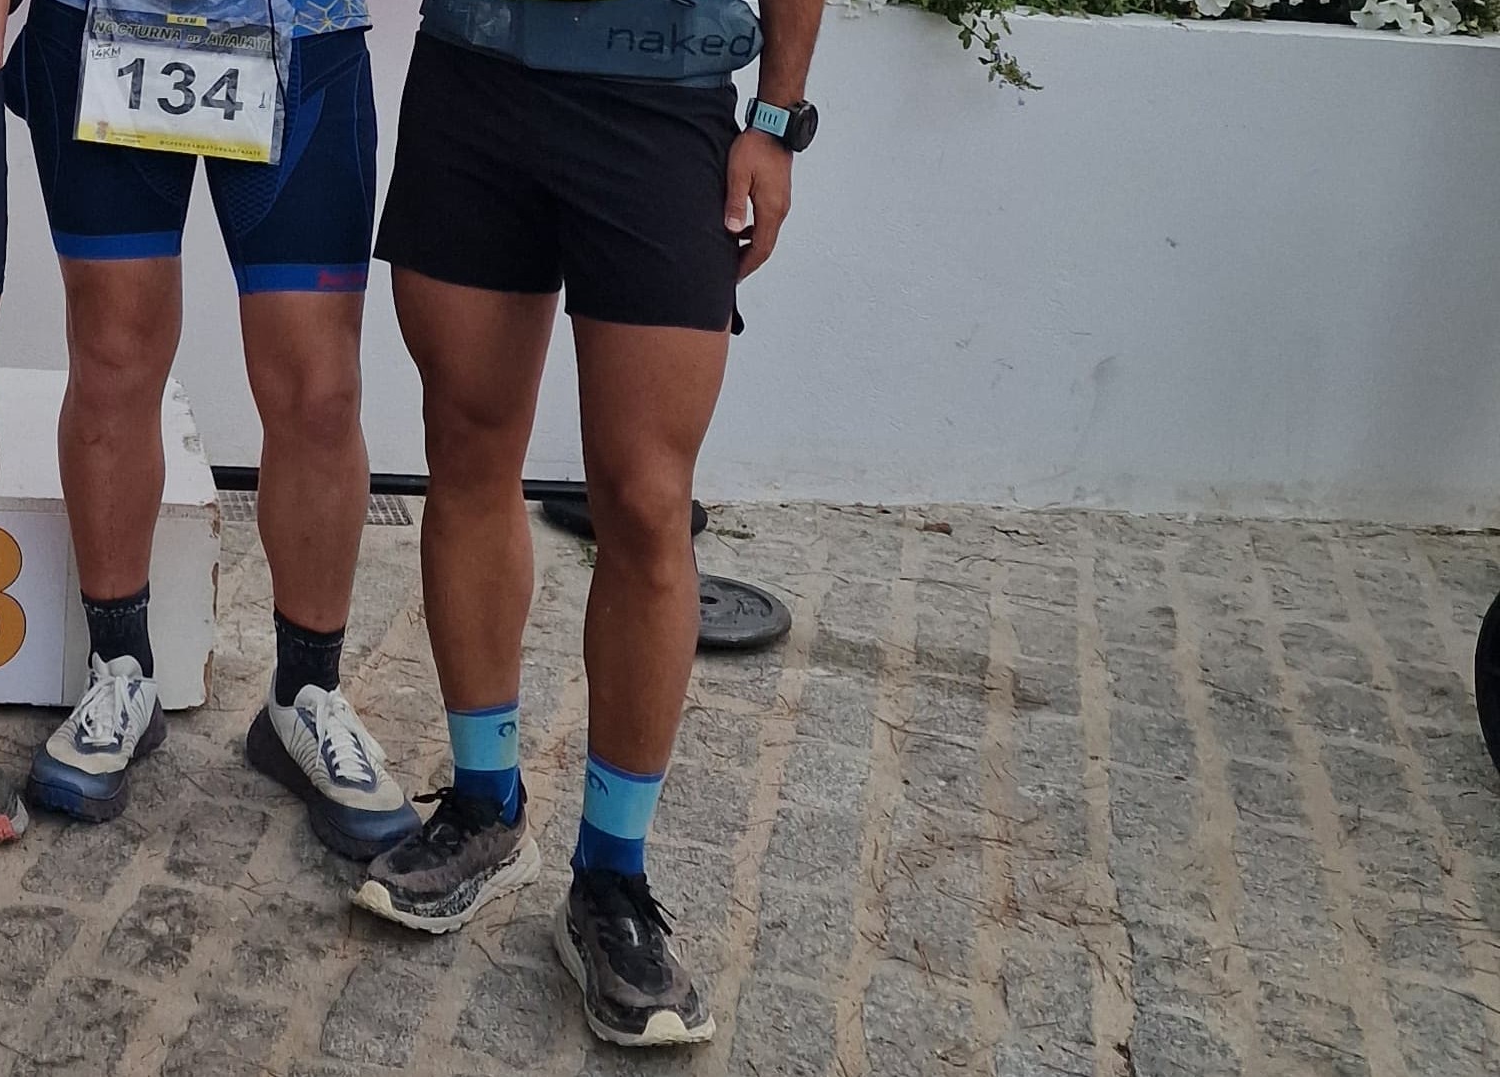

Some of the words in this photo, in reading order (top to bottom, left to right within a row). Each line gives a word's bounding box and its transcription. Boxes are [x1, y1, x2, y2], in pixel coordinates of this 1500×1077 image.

[94, 23, 181, 40] NOCTURNA
[607, 26, 755, 57] naked
[91, 47, 121, 58] 14KM
[117, 58, 243, 120] 134
